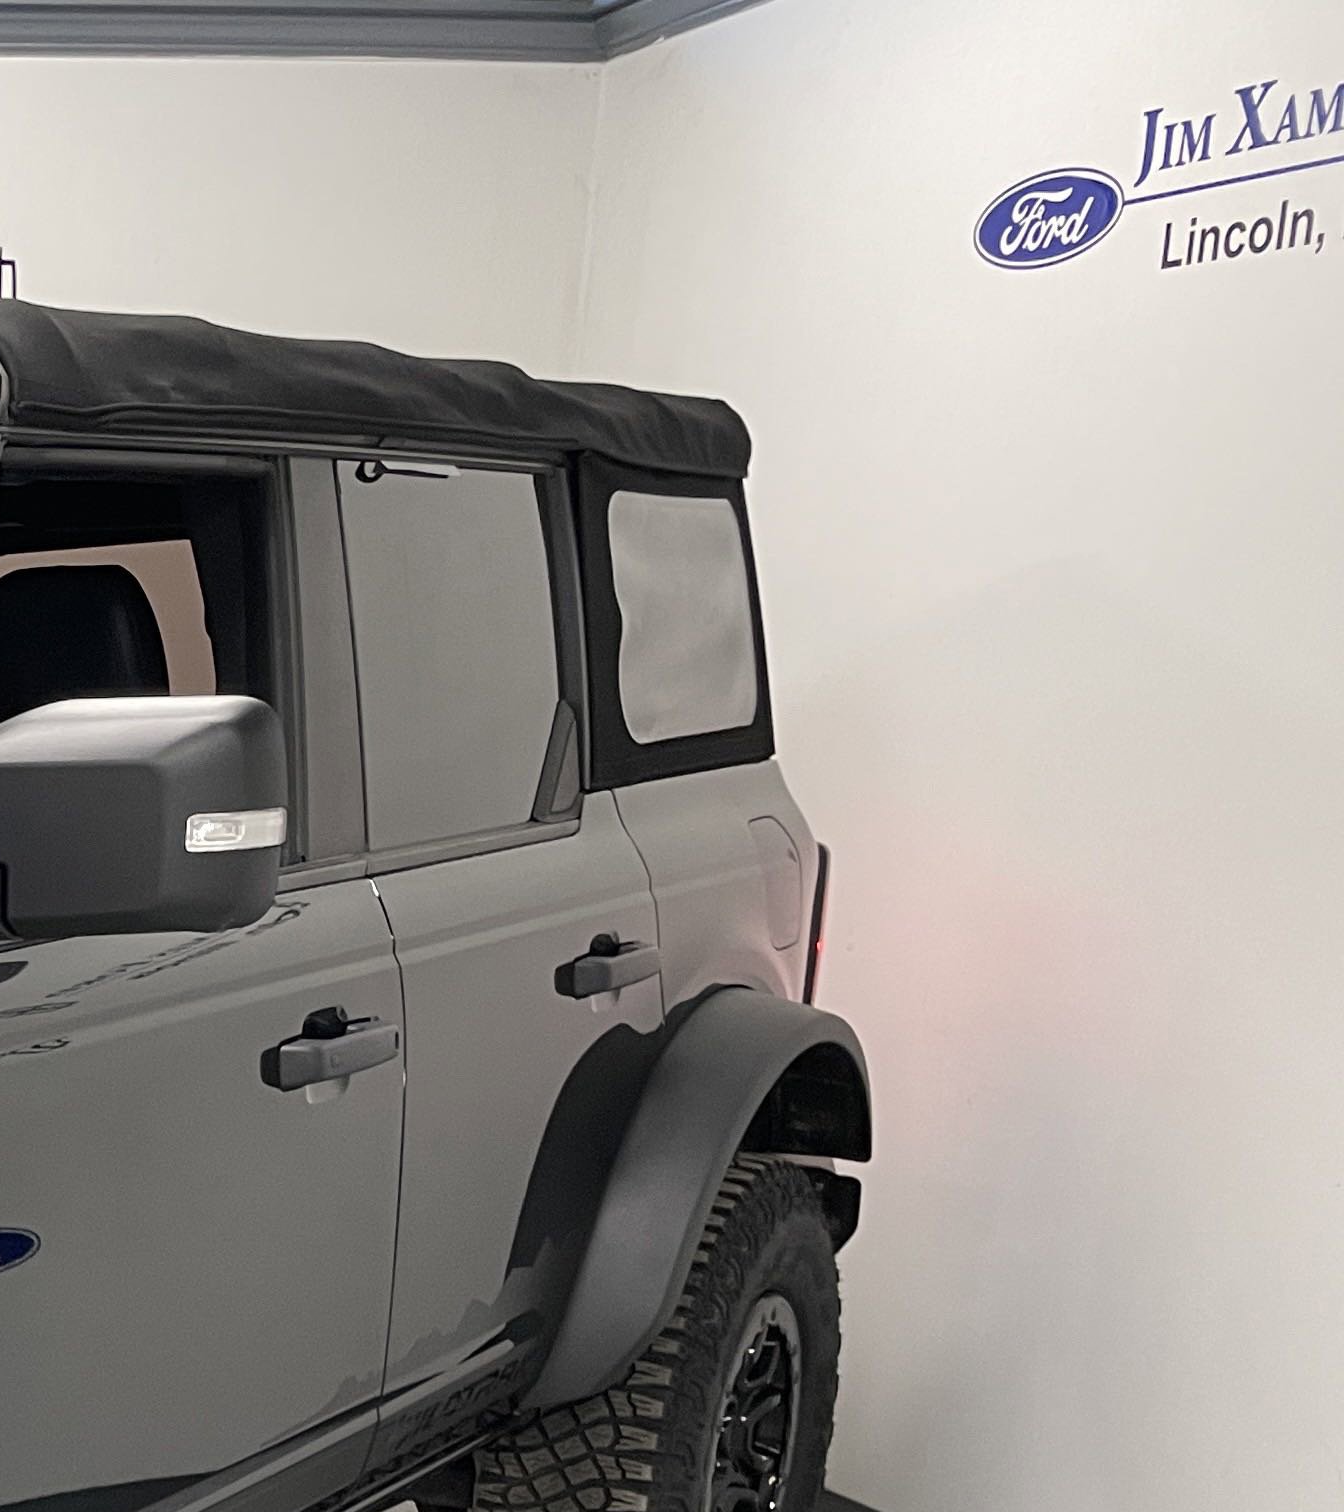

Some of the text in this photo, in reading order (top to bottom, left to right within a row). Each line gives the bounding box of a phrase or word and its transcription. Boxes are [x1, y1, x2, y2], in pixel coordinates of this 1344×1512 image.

[1134, 79, 1344, 187] JIM XAM
[999, 187, 1094, 255] Ford
[1161, 200, 1326, 269] Lincoln,
